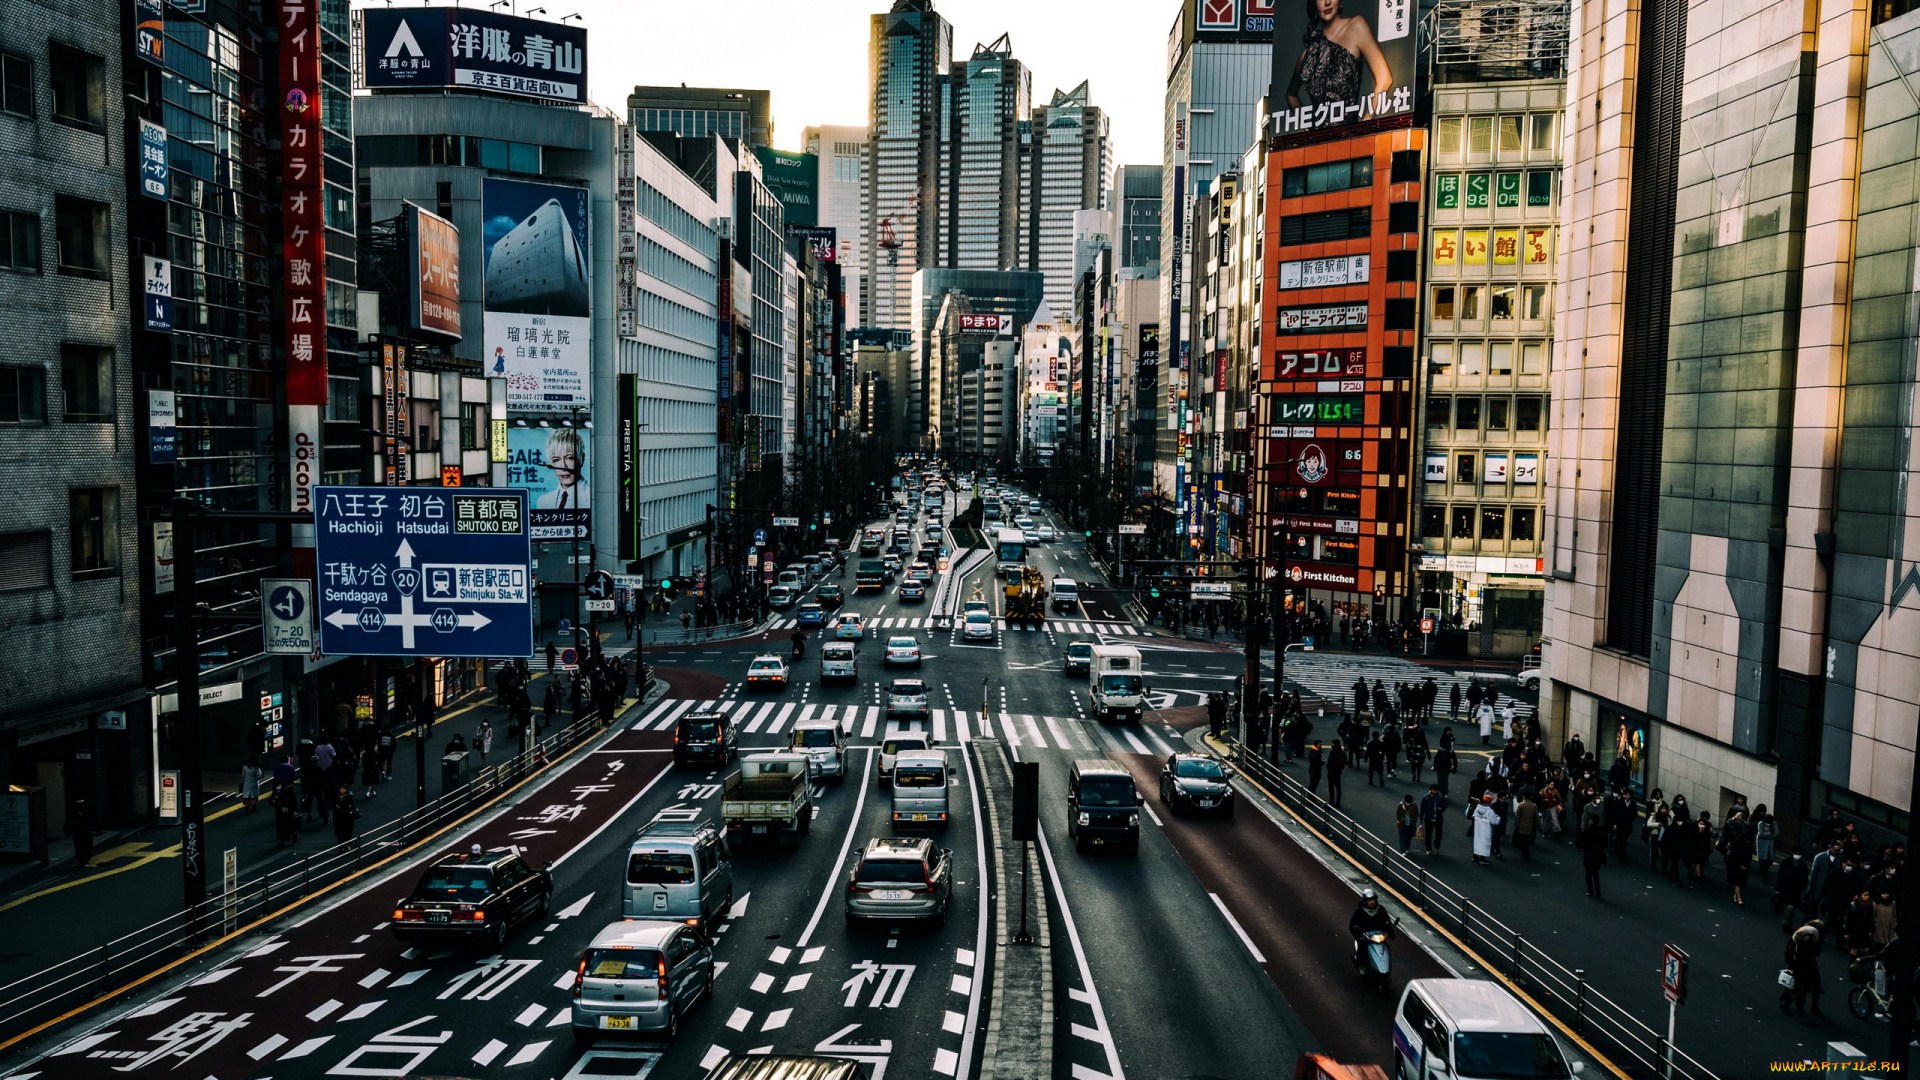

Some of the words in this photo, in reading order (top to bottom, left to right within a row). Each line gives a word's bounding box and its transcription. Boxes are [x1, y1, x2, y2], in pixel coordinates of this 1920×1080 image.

[449, 23, 583, 76] 洋服の青山
[378, 58, 431, 70] 洋服の青山
[471, 71, 564, 96] 京王百貨店向い
[1271, 86, 1412, 134] THEグローバル社
[144, 125, 164, 143] AEON
[1175, 119, 1183, 141] LABI
[142, 161, 167, 179] イーオン
[1441, 174, 1516, 192] ほぐし
[783, 192, 811, 206] MIWA
[1444, 193, 1519, 208] 2,980円
[288, 123, 314, 363] カラオケ歌広場
[1435, 237, 1517, 260] 占い館
[1303, 258, 1346, 275] 新宿駅前
[1354, 257, 1364, 281] 歯科
[147, 279, 169, 294] テイケイ
[1287, 273, 1348, 287] デンタルクリニック
[961, 315, 998, 327] やまや
[1302, 312, 1367, 327] エーアイアール
[507, 327, 571, 345] 瑠璃光院
[516, 345, 562, 360] 白蓮華堂
[1349, 351, 1363, 362] 6F
[1281, 352, 1341, 375] アコム
[1342, 382, 1362, 391] アコム
[624, 419, 634, 472] PRESTIA
[322, 494, 389, 517] 八王子
[399, 494, 446, 519] 初台
[456, 499, 518, 519] 首都高
[530, 513, 589, 523] キンクリニク
[328, 520, 384, 536] Hachioji
[396, 521, 449, 535] Hatsudai
[457, 520, 499, 532] SHUTOKO
[501, 520, 519, 532] EXP
[397, 573, 415, 587] 20
[458, 567, 524, 587] 新宿駅西口
[1303, 571, 1322, 581] First
[1323, 572, 1355, 584] Kitchen
[325, 588, 388, 604] Sendagaya
[459, 589, 496, 601] Shinjuku
[361, 613, 381, 626] 414
[434, 613, 454, 626] 414
[269, 637, 310, 648] この先50m
[203, 691, 223, 700] SELECT
